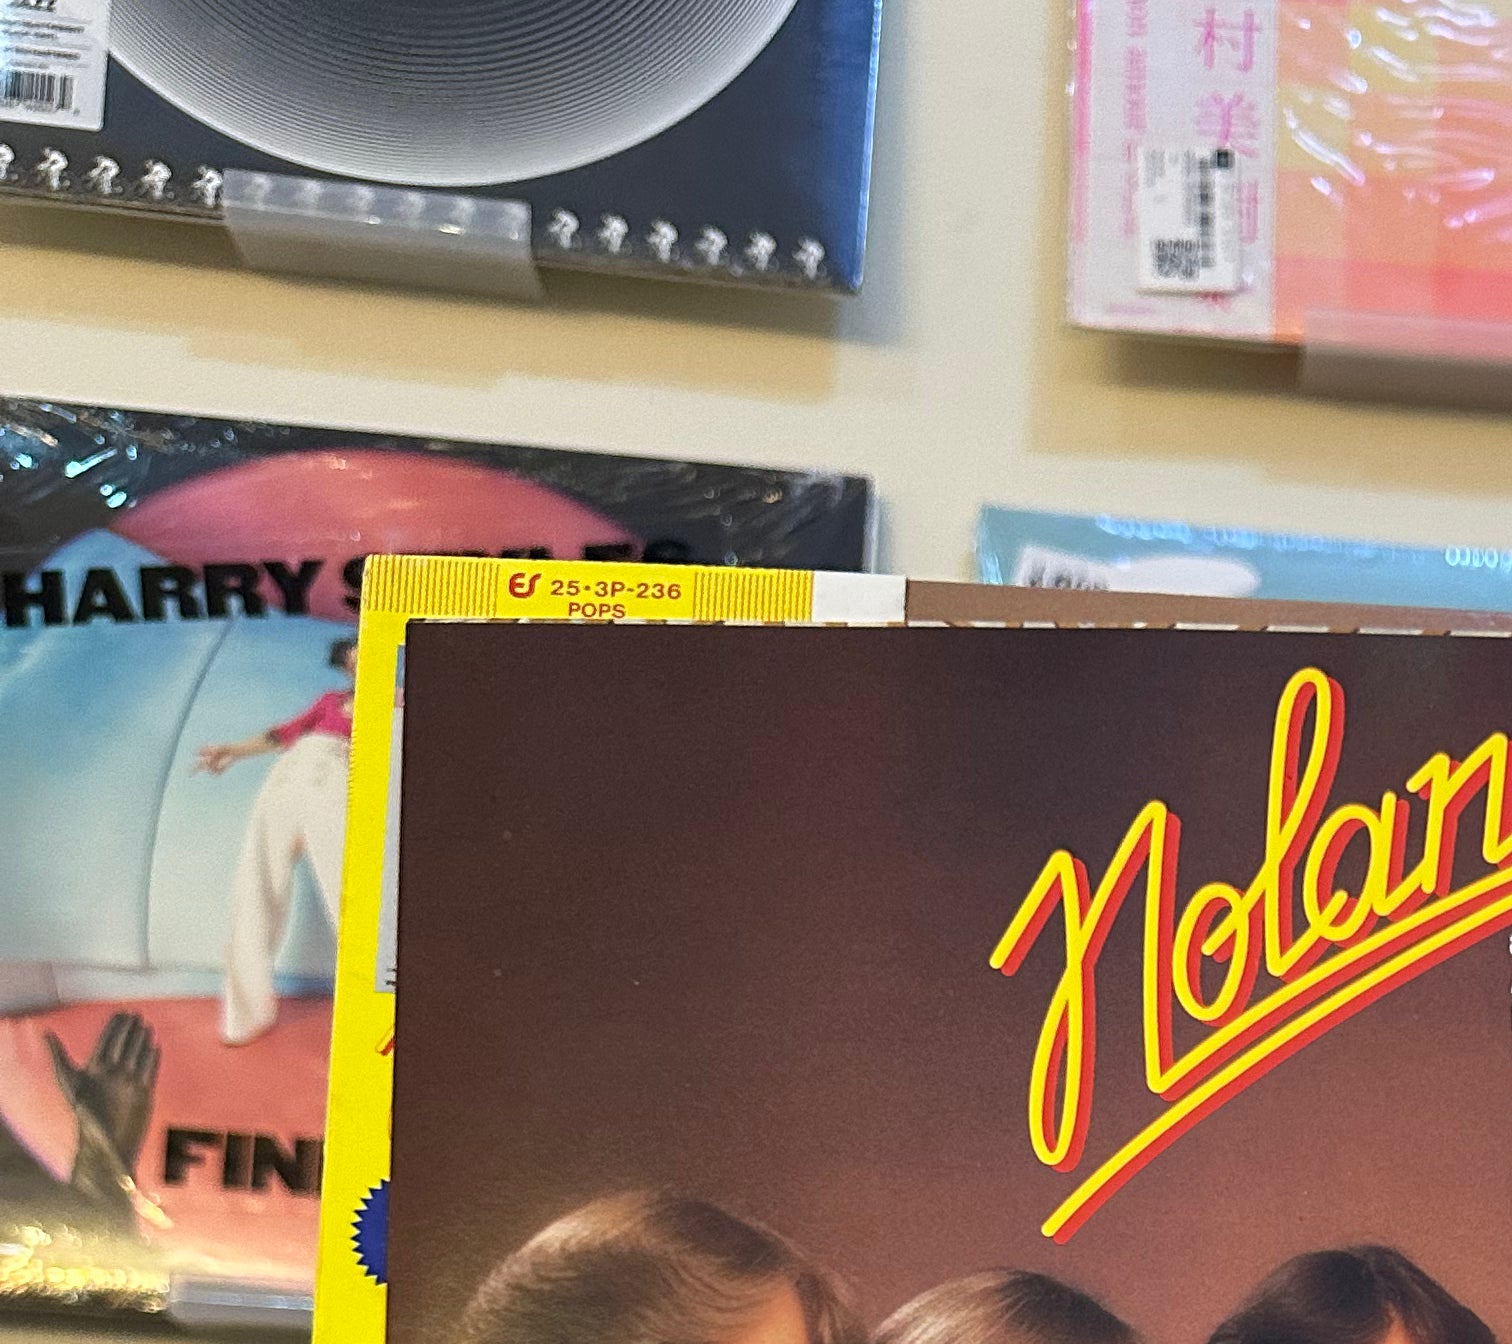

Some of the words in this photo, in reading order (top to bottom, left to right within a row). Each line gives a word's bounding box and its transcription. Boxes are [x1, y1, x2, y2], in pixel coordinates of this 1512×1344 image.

[2, 556, 325, 627] HARRY
[568, 602, 627, 619] POPS
[164, 1126, 322, 1201] FIN
